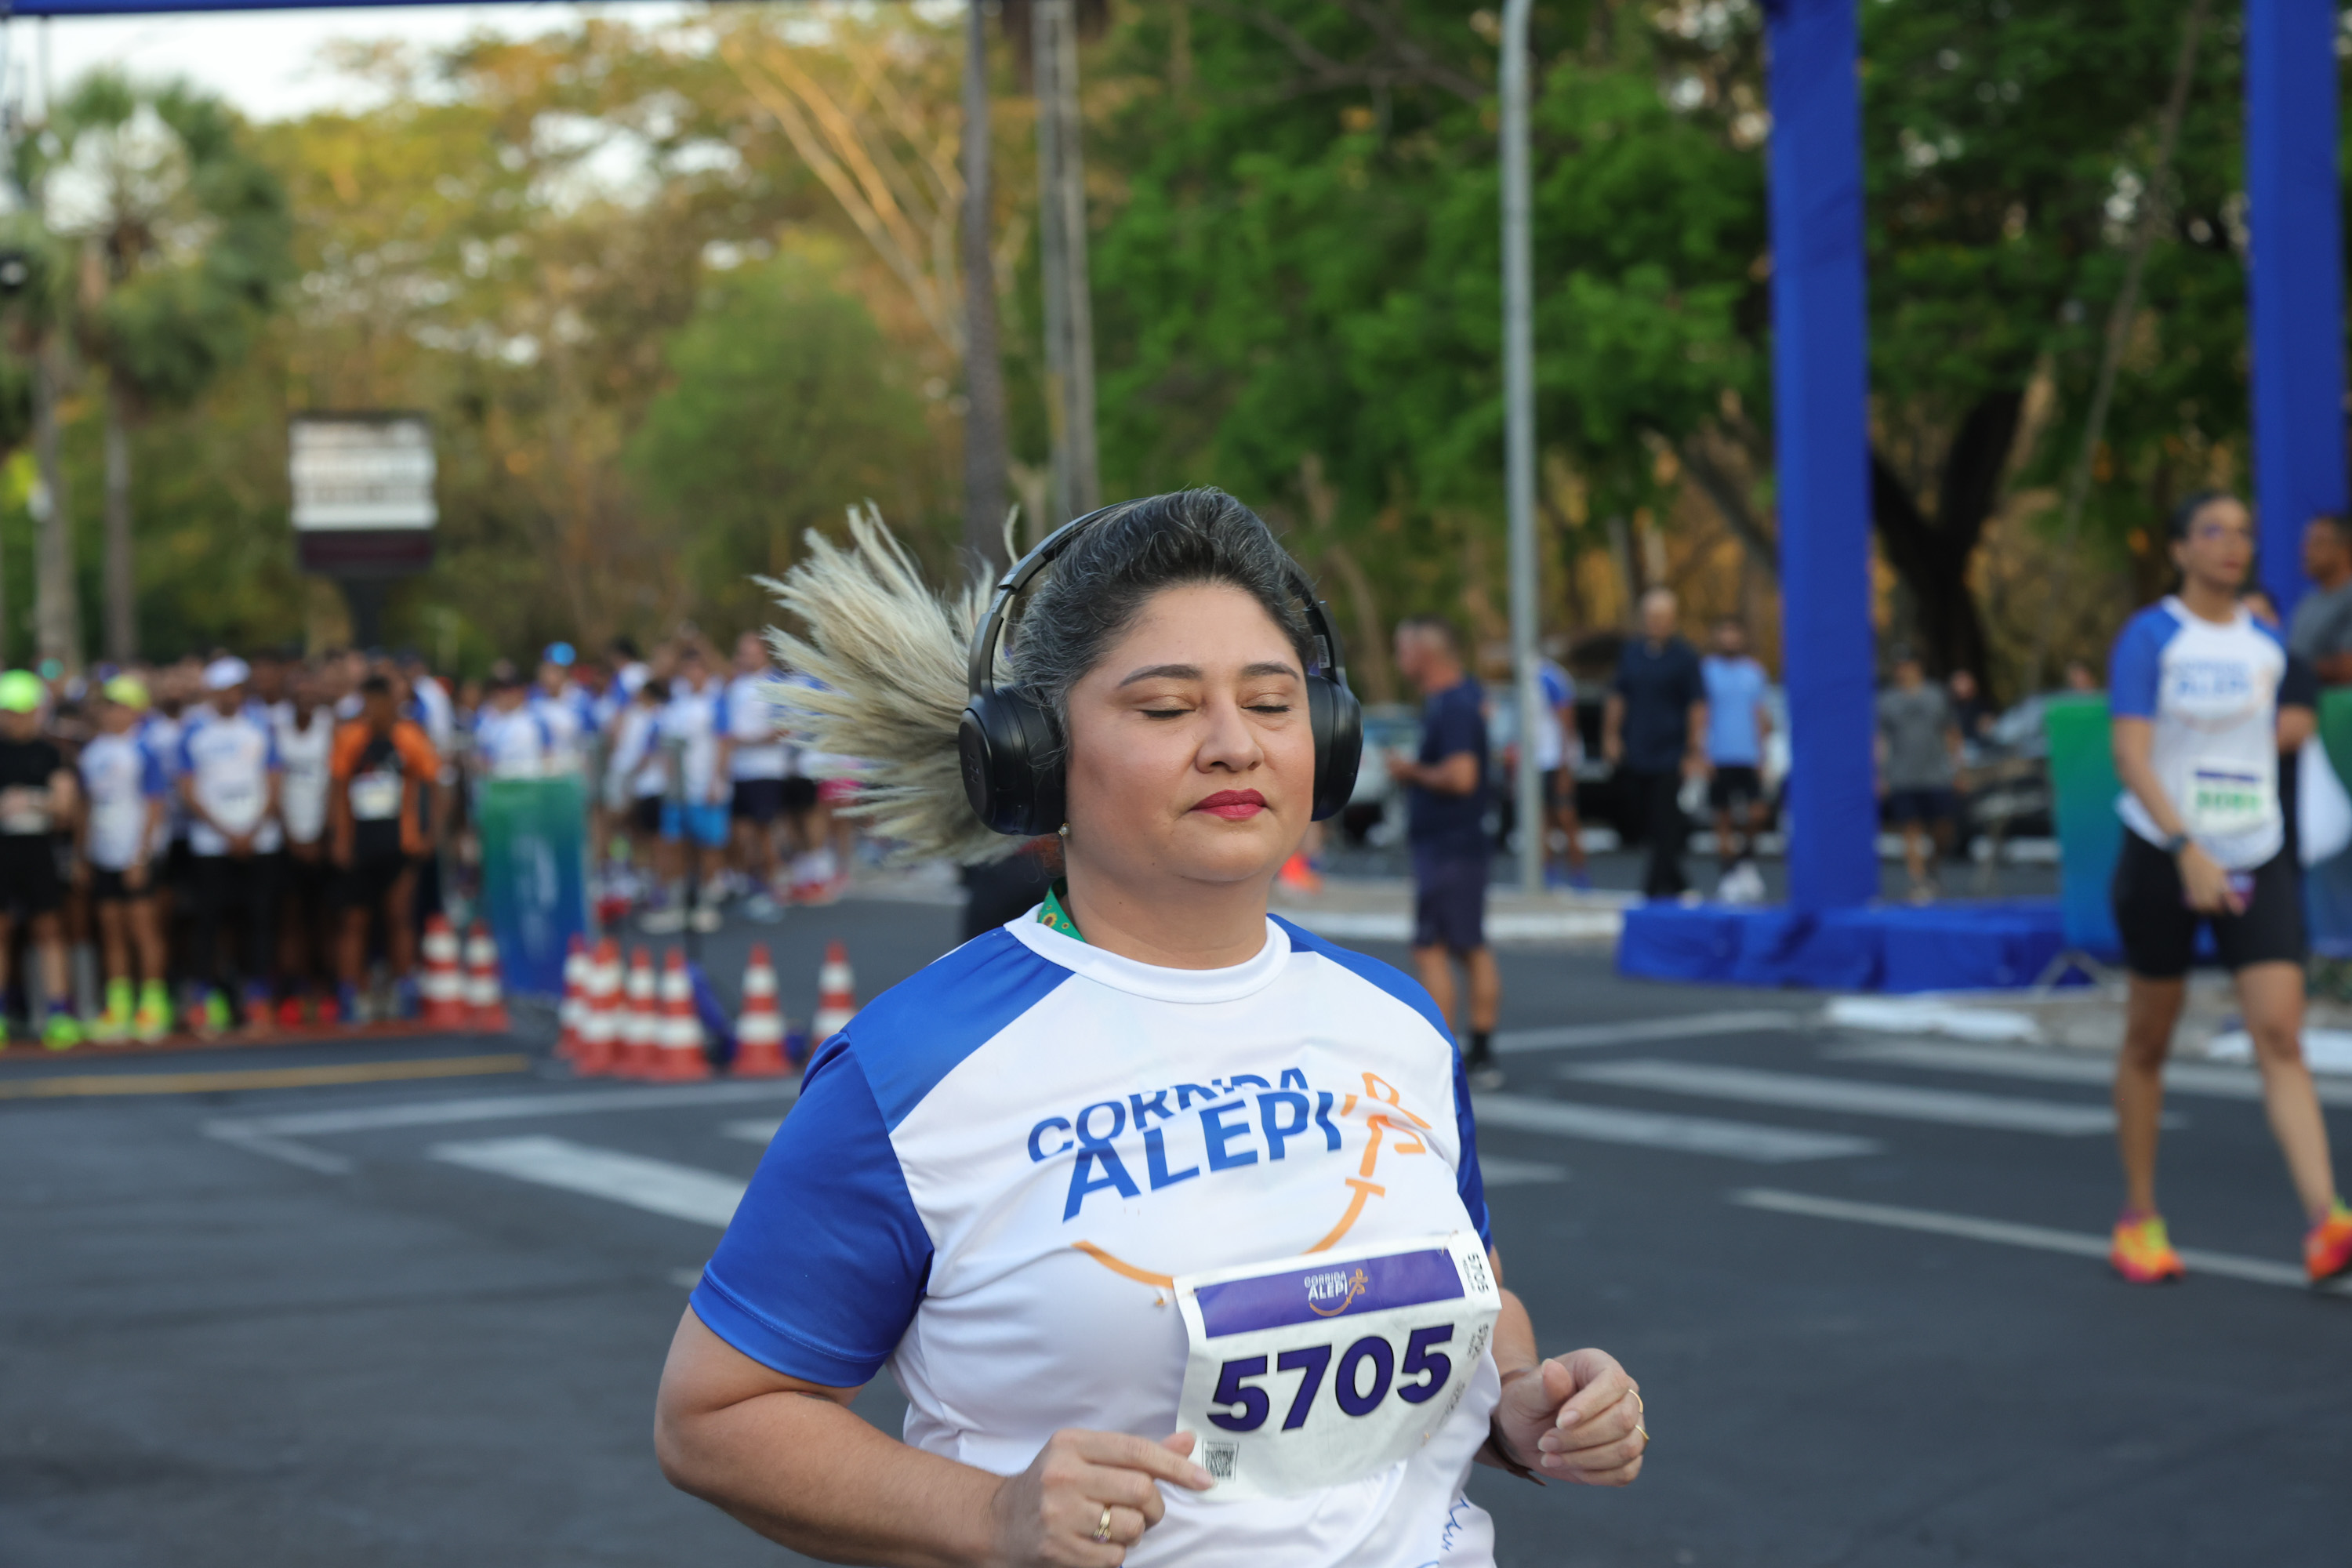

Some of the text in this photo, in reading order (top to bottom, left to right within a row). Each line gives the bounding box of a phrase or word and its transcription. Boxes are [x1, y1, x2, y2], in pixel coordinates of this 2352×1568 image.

[1062, 1091, 1342, 1225] ALEPI
[1304, 1270, 1348, 1288] CORRIDA
[1308, 1279, 1348, 1301] ALEPI
[1468, 1253, 1489, 1294] 5705
[1207, 1323, 1454, 1432] 5705
